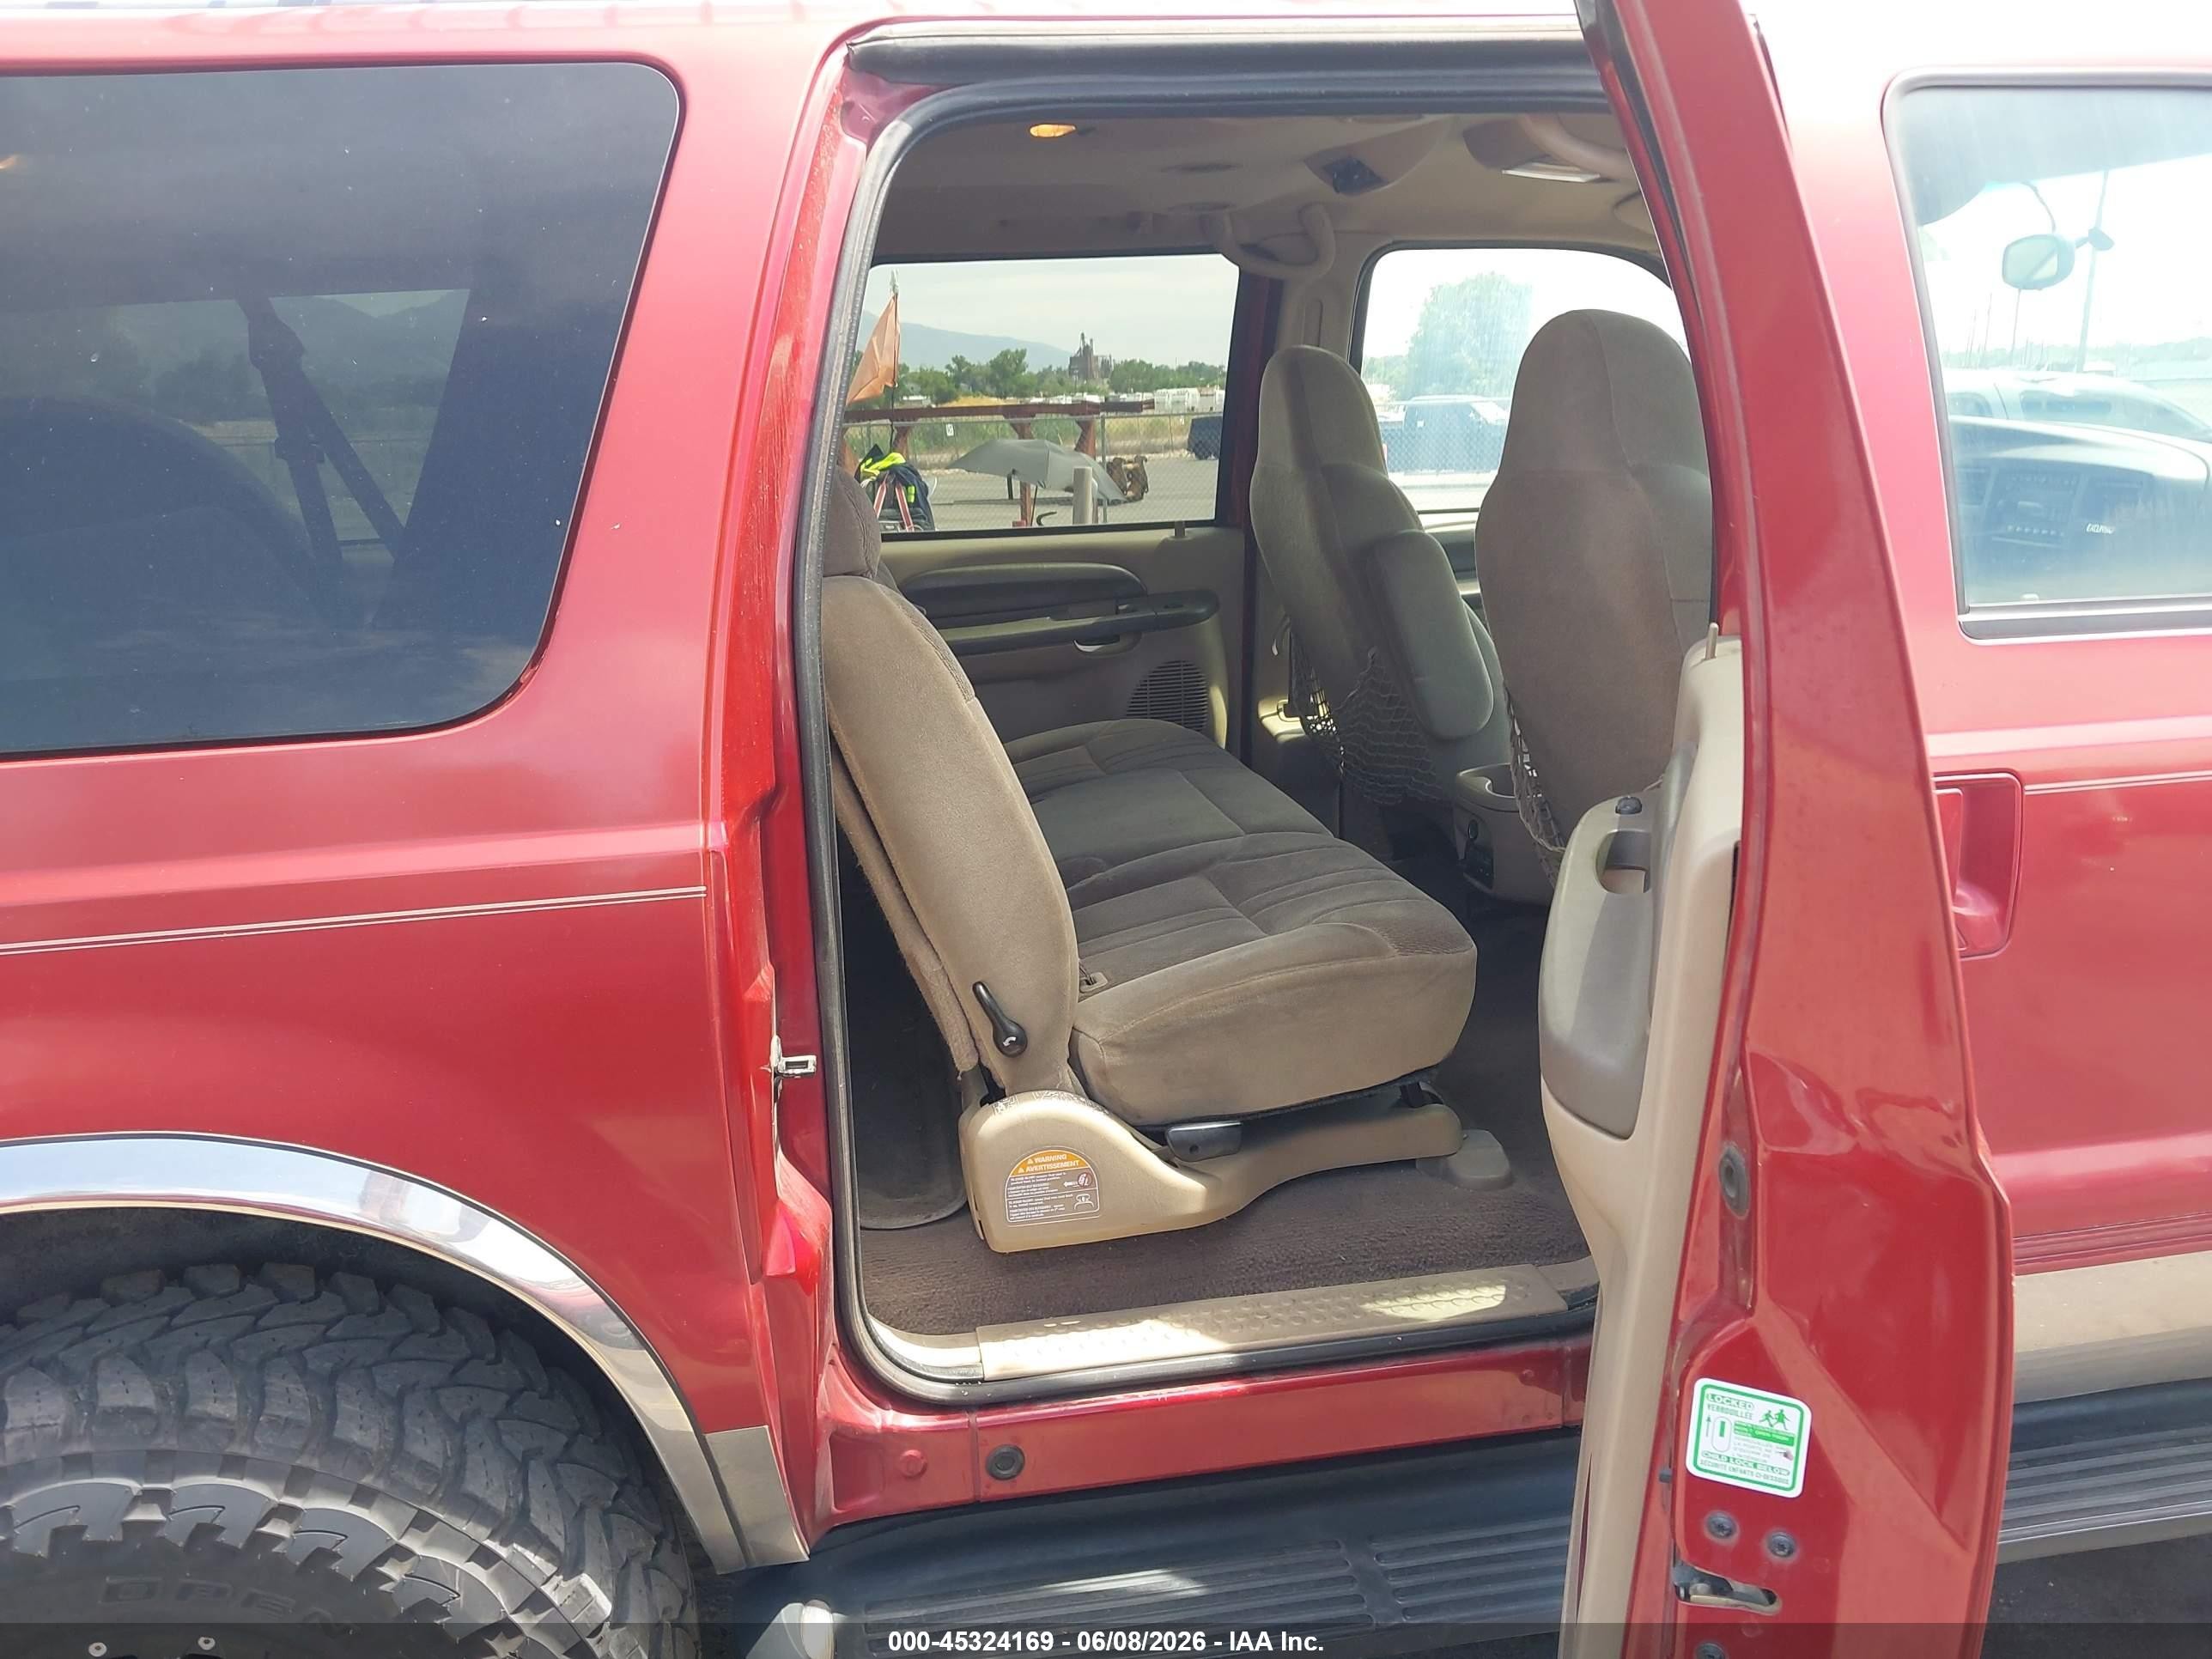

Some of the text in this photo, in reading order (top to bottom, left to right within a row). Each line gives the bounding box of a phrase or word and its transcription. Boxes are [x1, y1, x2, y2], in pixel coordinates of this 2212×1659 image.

[1034, 1154, 1067, 1164] WARNING
[1025, 1160, 1079, 1173] AVERTISSEMENT
[1707, 1394, 1753, 1410] LOCKED
